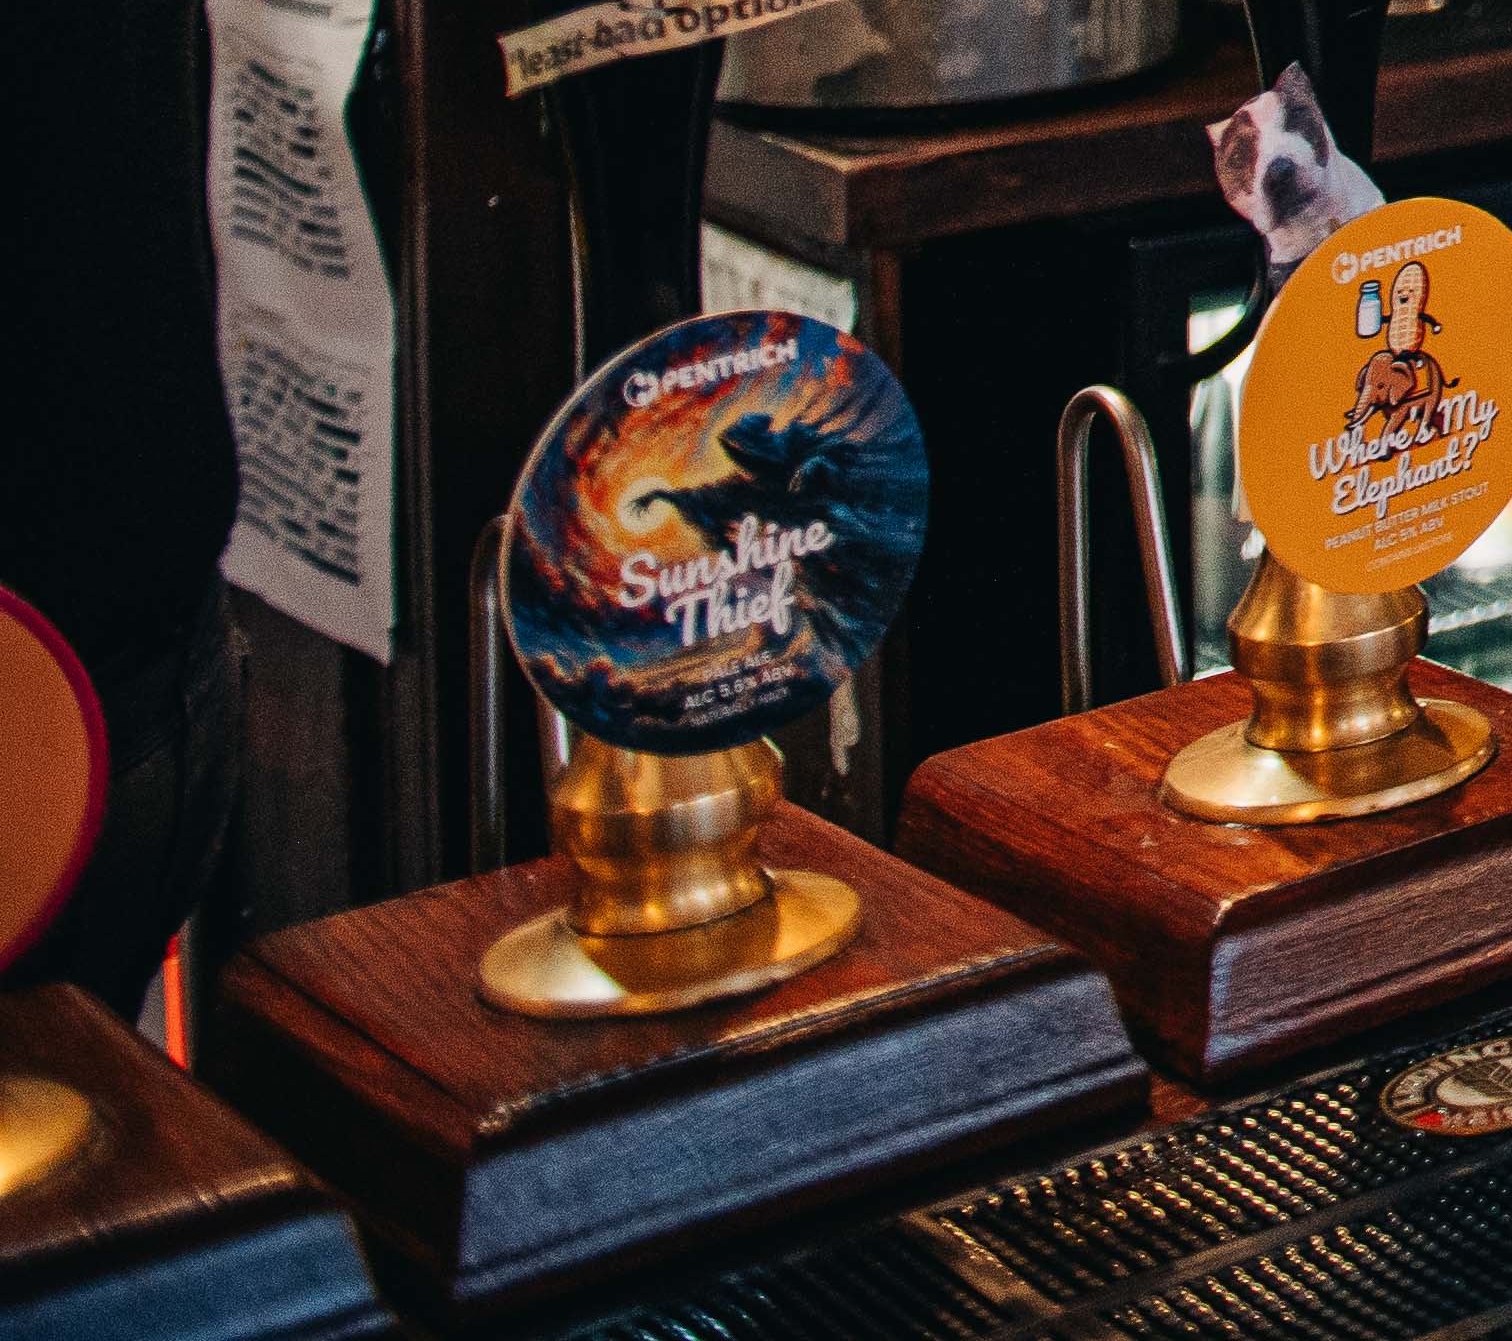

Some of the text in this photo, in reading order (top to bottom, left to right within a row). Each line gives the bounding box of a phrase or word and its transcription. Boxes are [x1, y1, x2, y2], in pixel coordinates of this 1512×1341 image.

[1361, 226, 1463, 272] PENTRICH
[661, 339, 799, 399] PENTRICH
[1308, 390, 1499, 481] Where's My
[1331, 432, 1479, 518] Elephant?
[1451, 482, 1489, 504] STOUT
[619, 513, 835, 608] Sunshine
[664, 561, 796, 647] Thief
